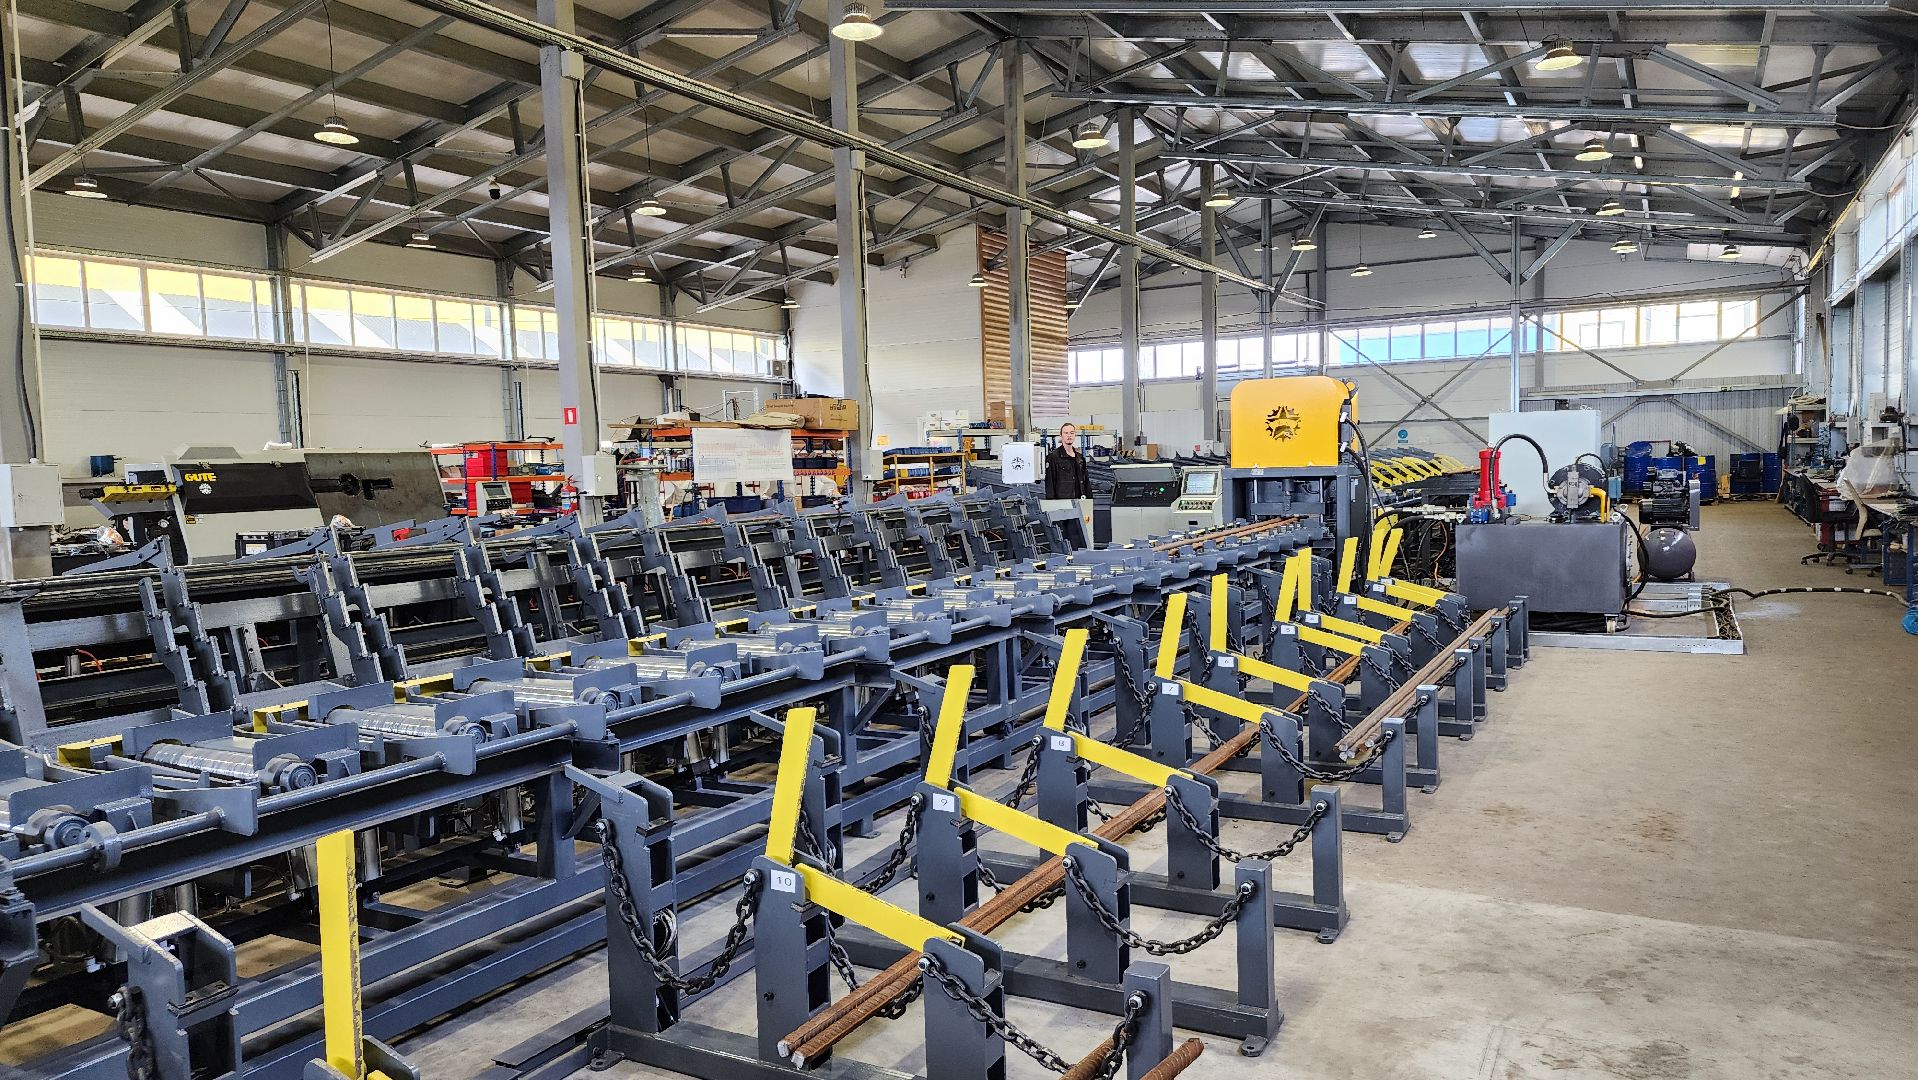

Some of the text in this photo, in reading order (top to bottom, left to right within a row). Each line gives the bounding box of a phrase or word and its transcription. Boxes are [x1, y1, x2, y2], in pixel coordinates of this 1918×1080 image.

[185, 473, 217, 481] GUTE
[940, 799, 948, 807] 9
[777, 876, 792, 887] 10
